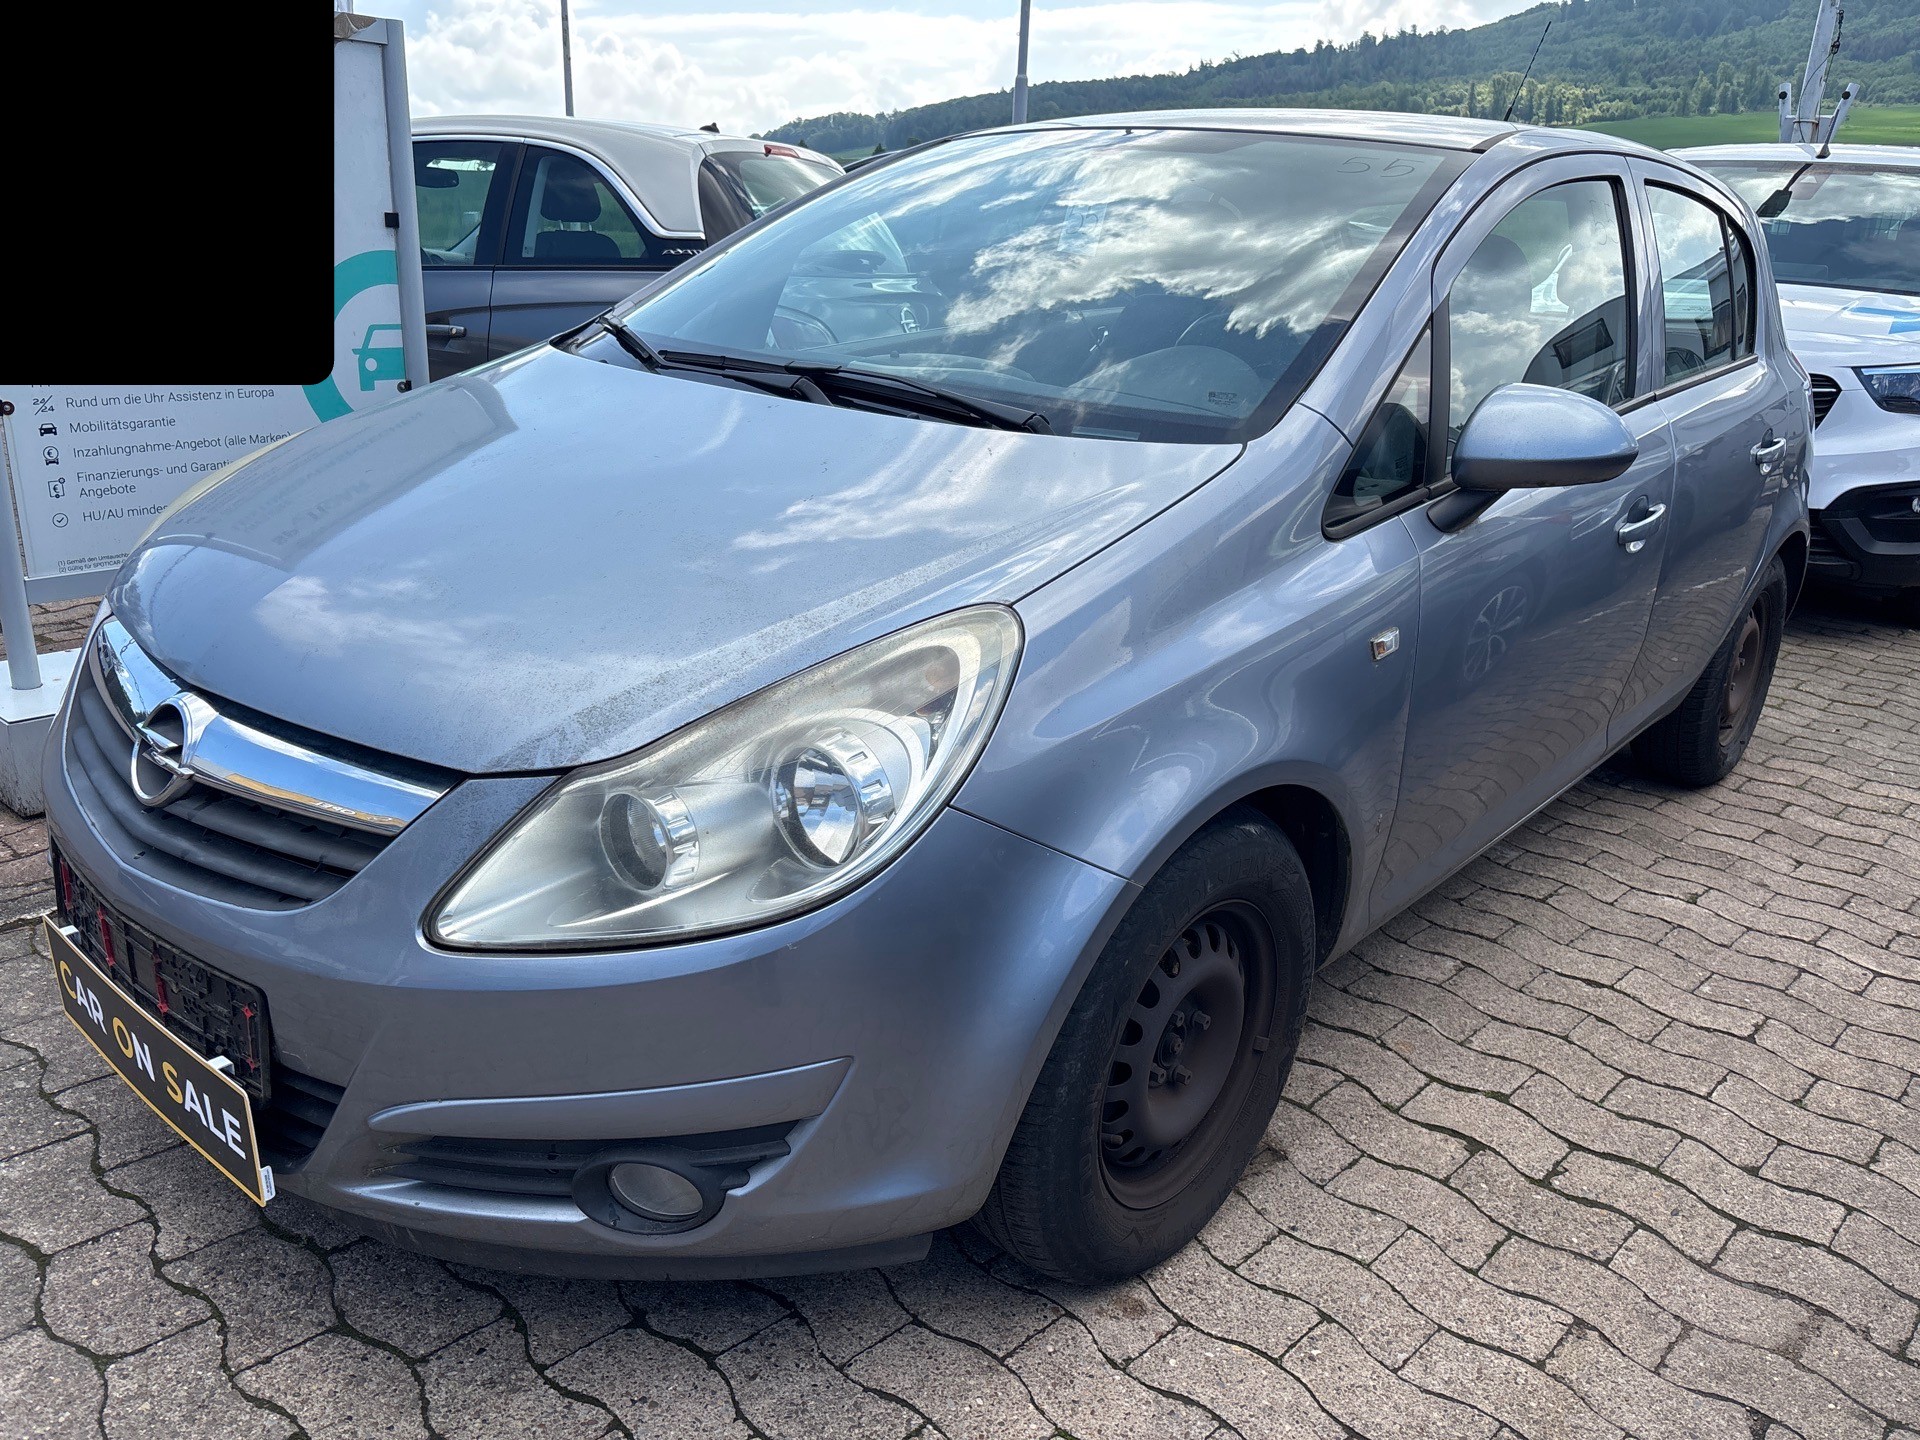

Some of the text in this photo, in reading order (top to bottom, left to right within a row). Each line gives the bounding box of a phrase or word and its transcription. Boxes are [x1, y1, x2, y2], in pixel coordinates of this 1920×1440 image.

[1336, 156, 1424, 177] 55
[65, 388, 275, 408] Rund um die Uhr Assistenz in Europa
[69, 416, 176, 433] Mobilitätsgarantie
[73, 438, 222, 458] Inzahlungnahme-Angebot
[224, 435, 247, 448] (alle
[76, 467, 163, 482] Finanzierungs-
[166, 463, 188, 475] und
[79, 483, 137, 498] Angebote
[82, 507, 125, 522] HU/AU
[59, 960, 247, 1160] CAR ON SALE
